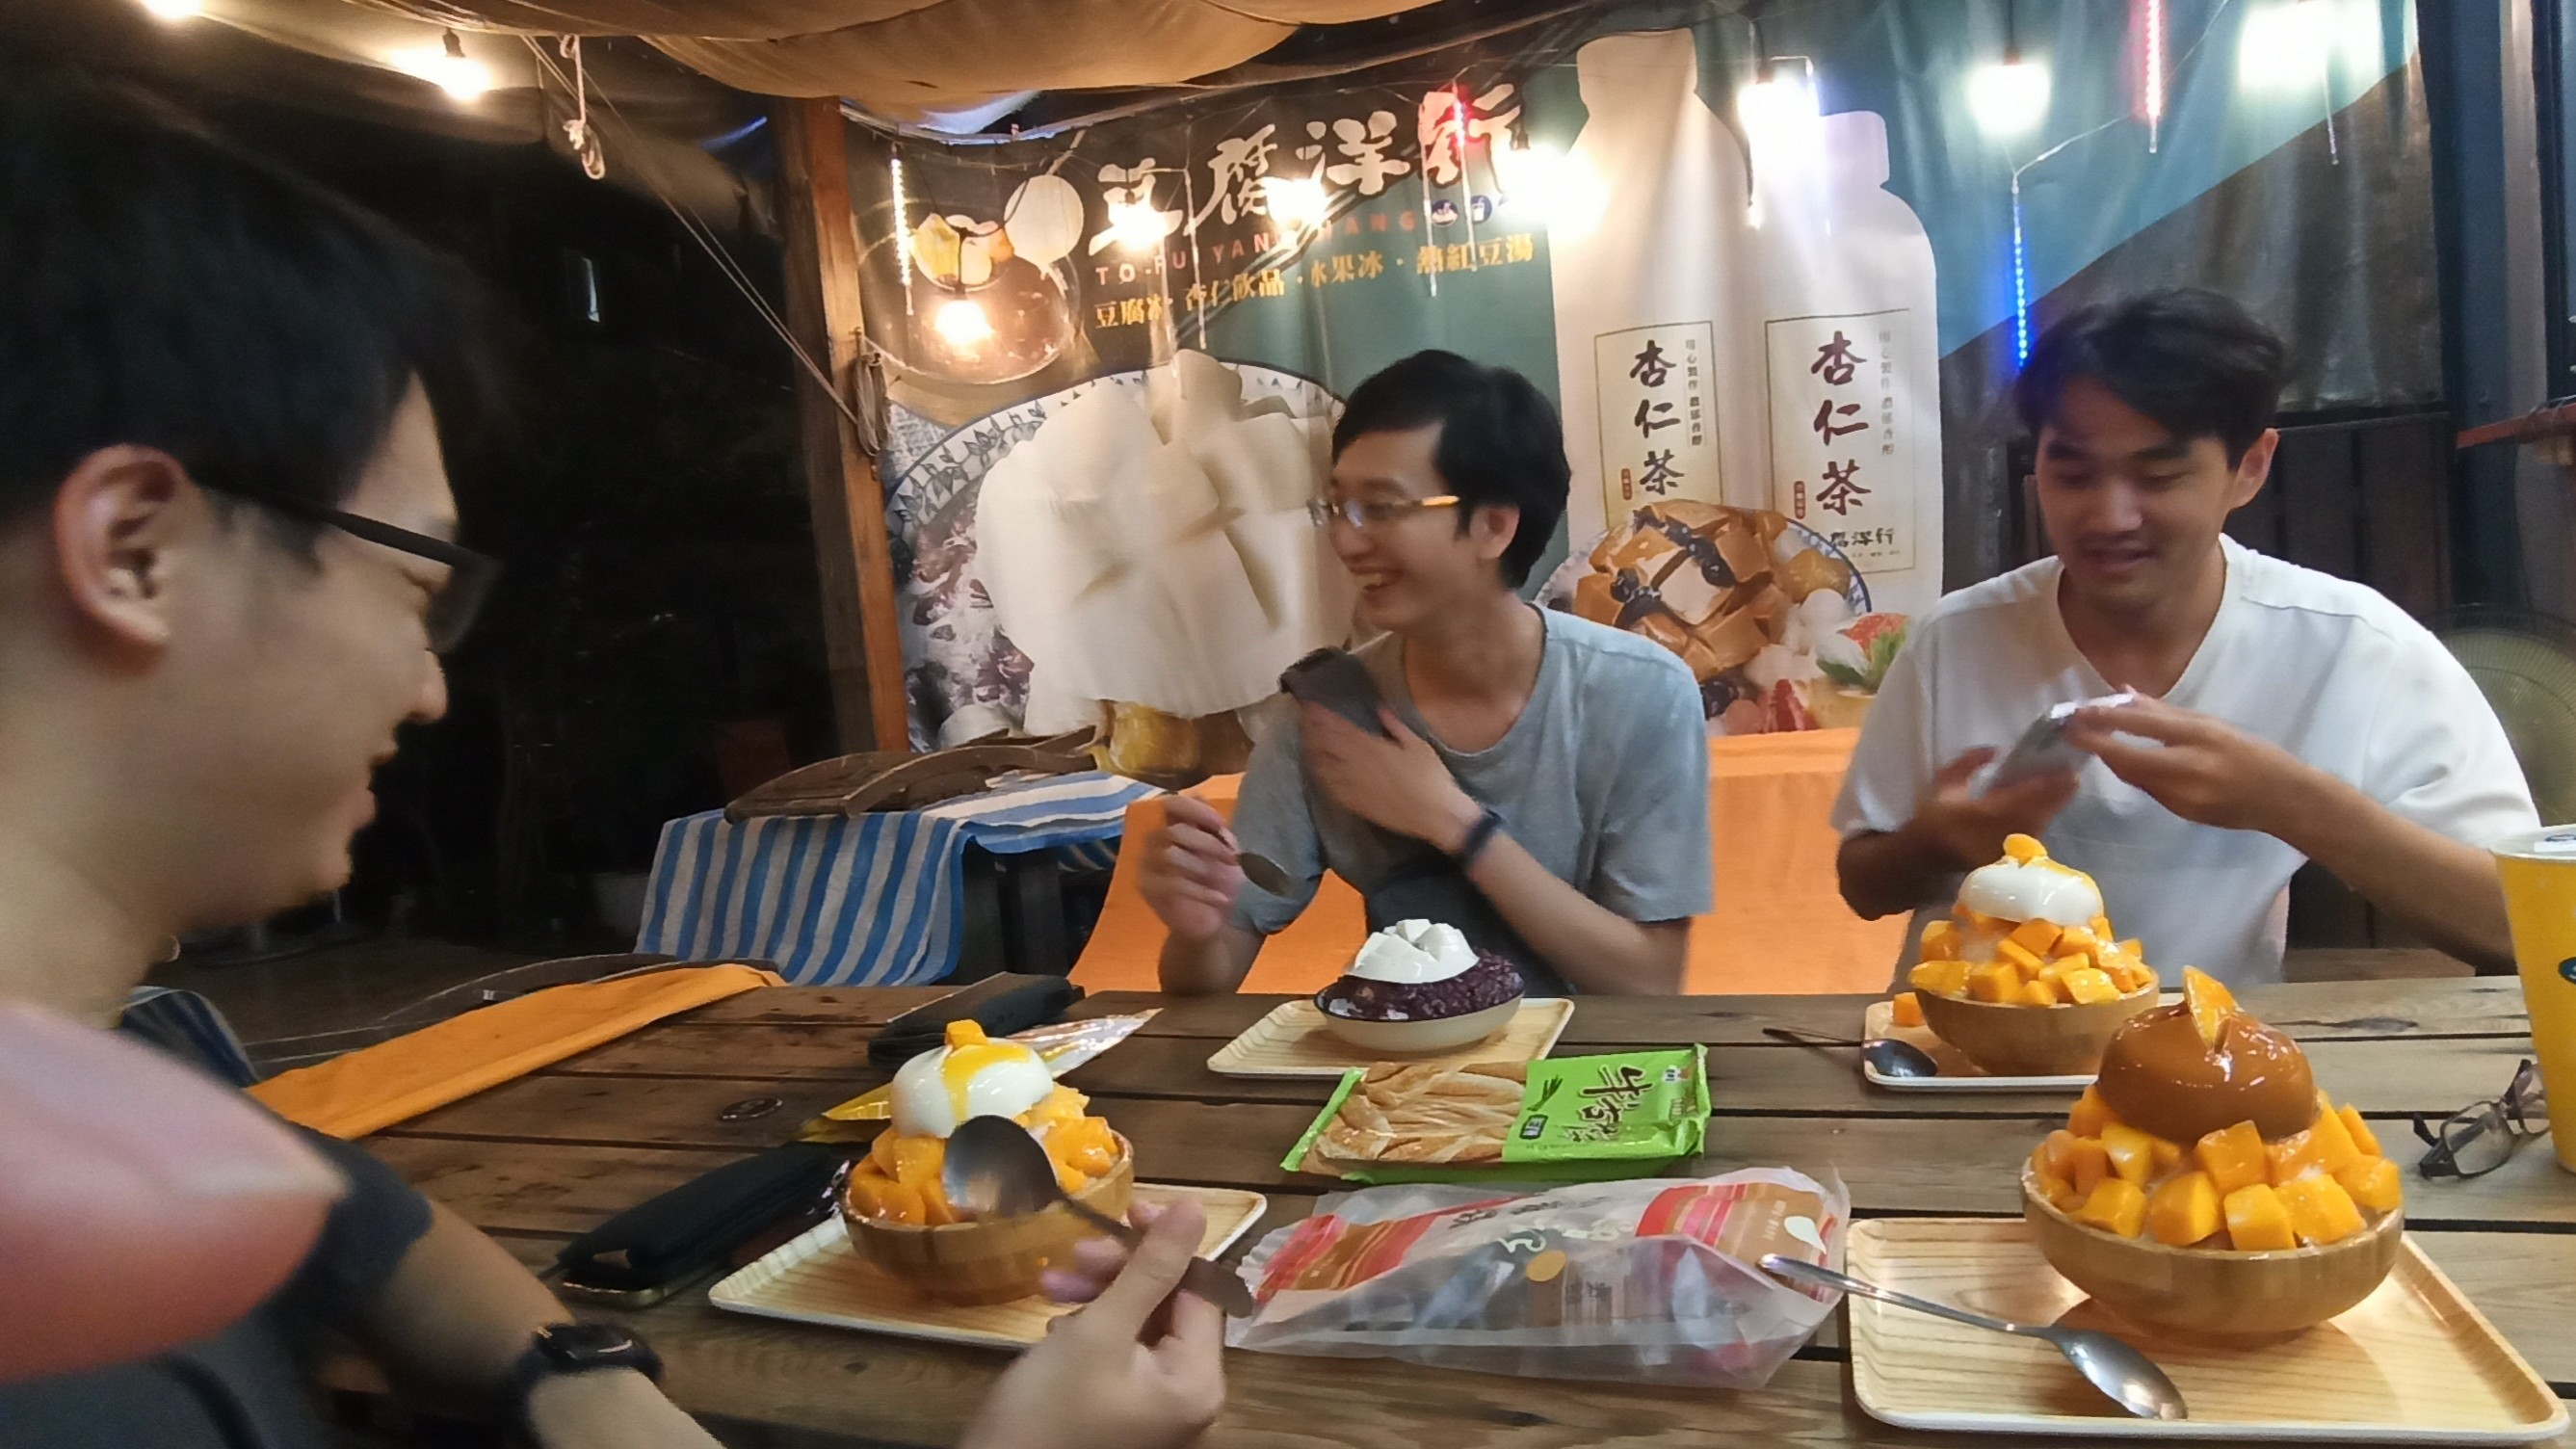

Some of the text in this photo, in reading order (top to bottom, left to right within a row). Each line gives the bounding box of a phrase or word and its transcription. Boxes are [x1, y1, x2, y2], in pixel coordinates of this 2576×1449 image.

[1629, 339, 1685, 496] 杏仁茶
[1811, 330, 1872, 516] 杏仁茶
